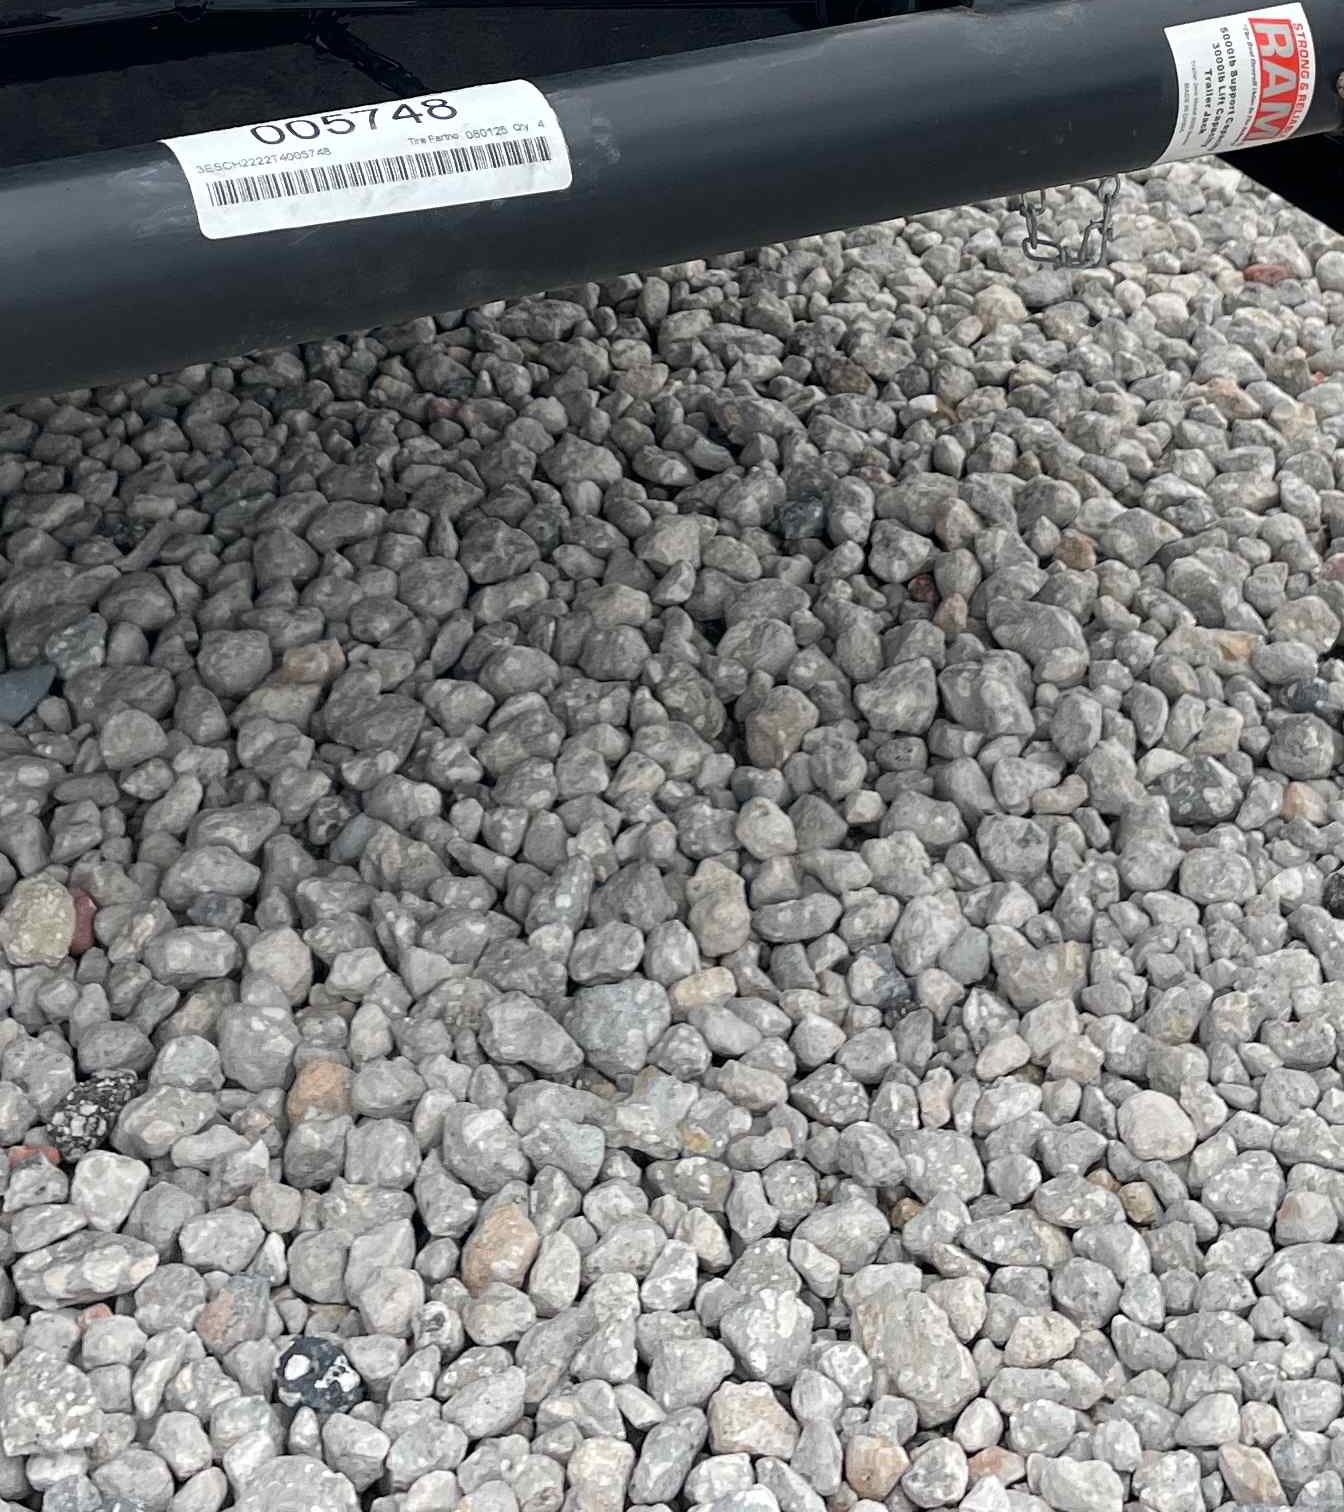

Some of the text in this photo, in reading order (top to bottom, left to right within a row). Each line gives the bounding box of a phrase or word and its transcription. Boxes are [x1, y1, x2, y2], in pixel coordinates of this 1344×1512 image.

[1212, 42, 1226, 83] 3000lb
[1219, 26, 1238, 68] 5000lb
[1293, 23, 1310, 79] STRONG
[1197, 68, 1214, 136] Trailer Jack
[1217, 85, 1226, 105] Lift
[1226, 70, 1239, 115] Support
[1248, 20, 1298, 141] RAM
[1299, 80, 1310, 91] &
[250, 99, 458, 145] 005748
